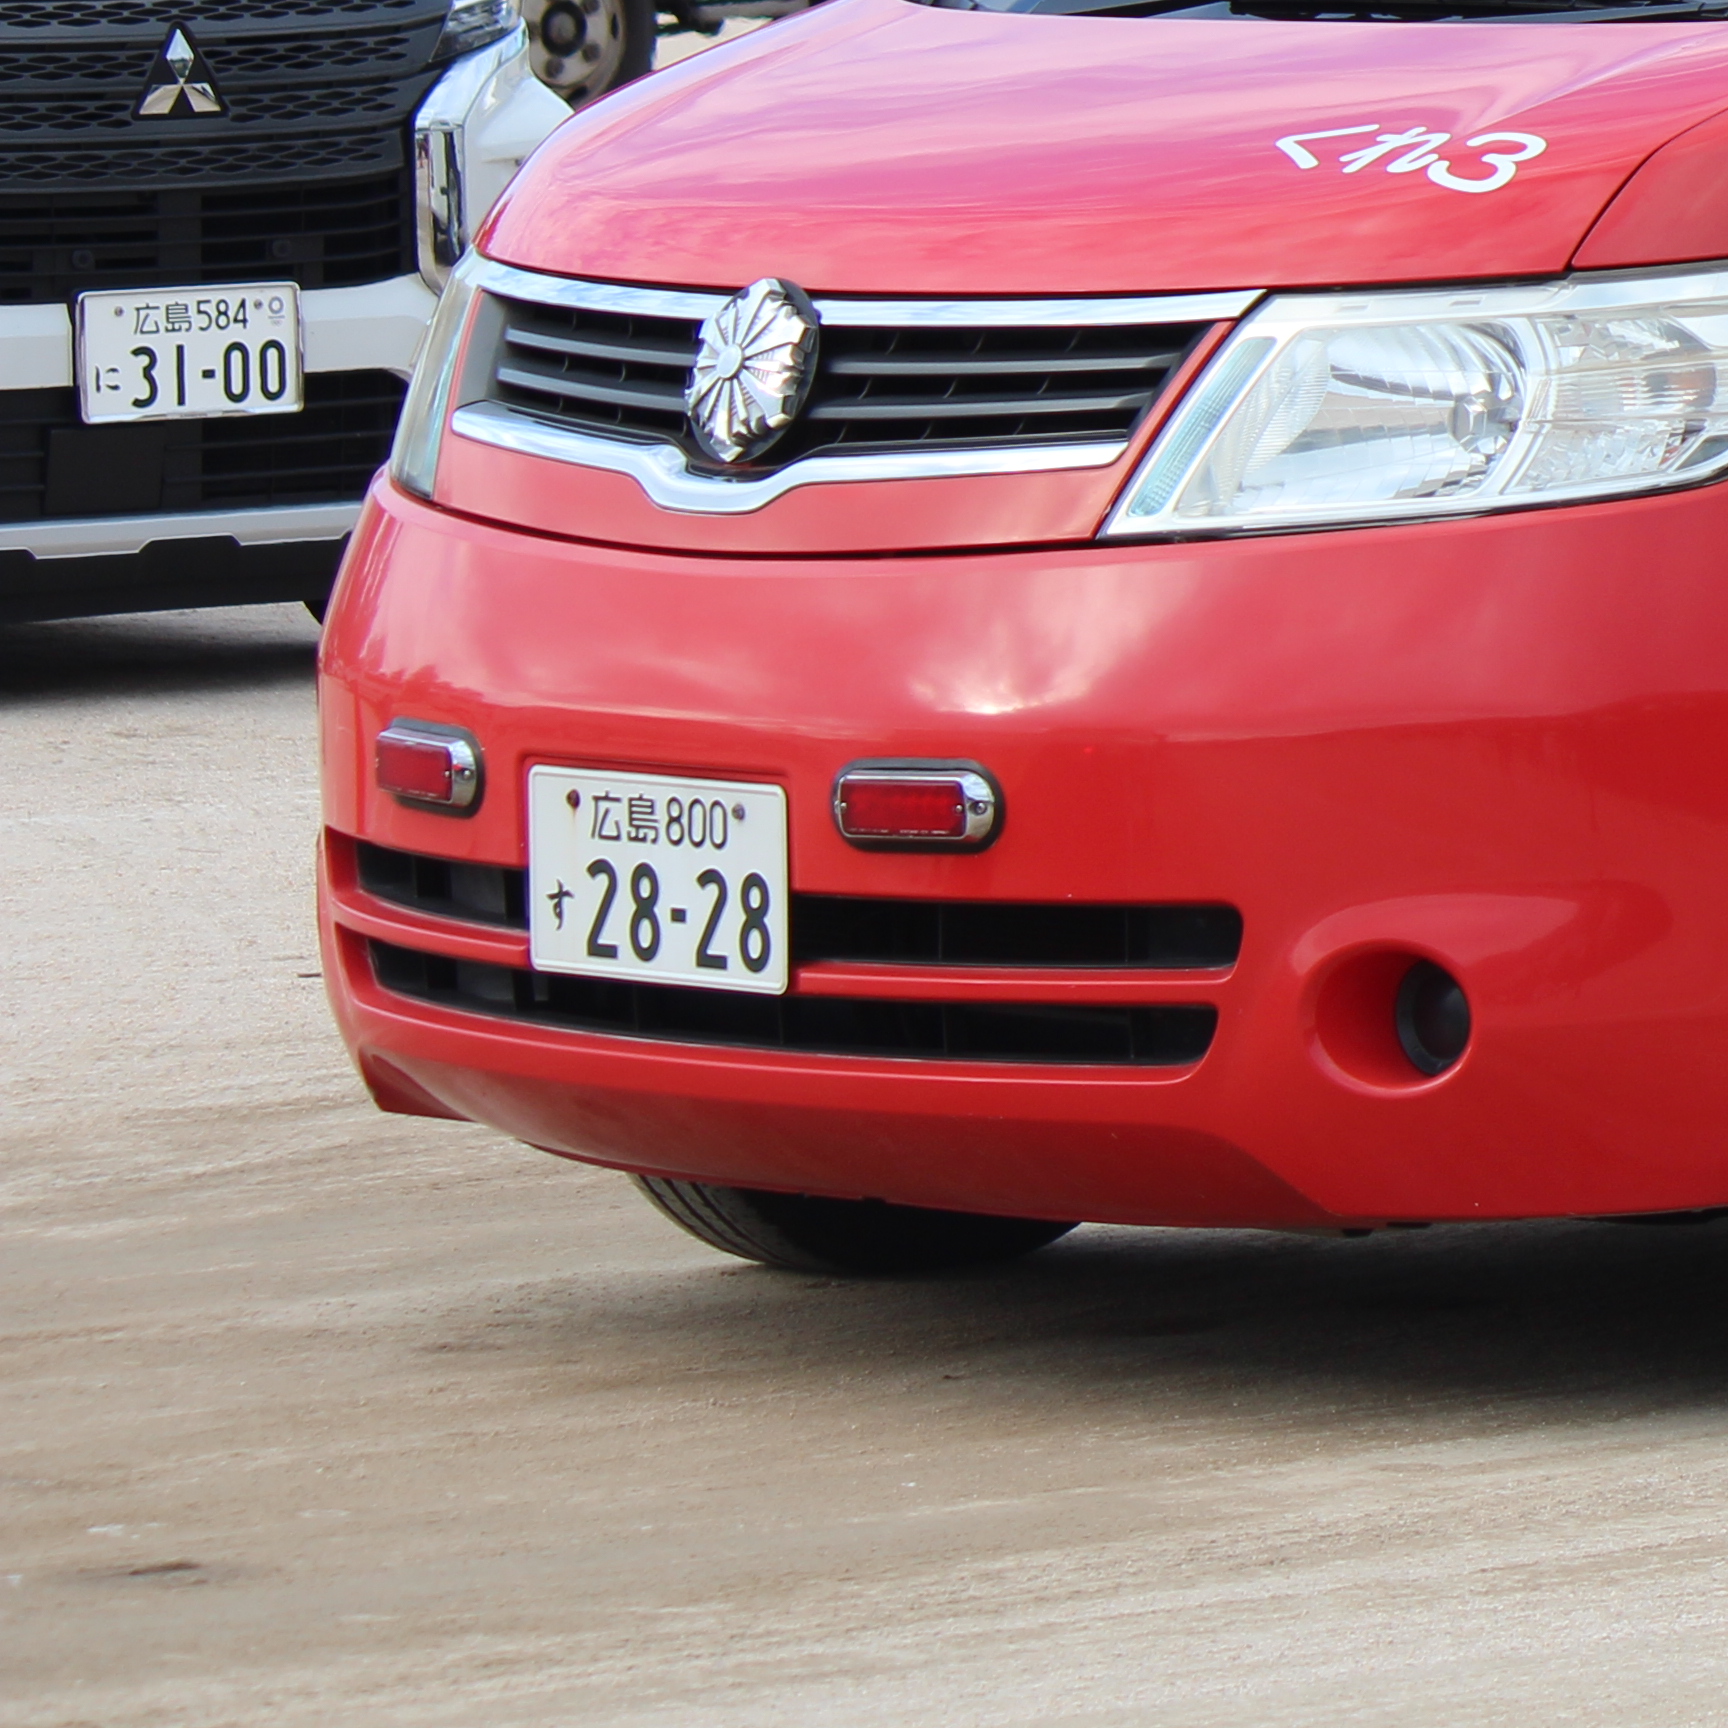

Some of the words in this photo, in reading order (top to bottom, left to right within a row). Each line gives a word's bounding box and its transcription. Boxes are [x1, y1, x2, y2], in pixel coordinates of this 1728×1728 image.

[1274, 123, 1548, 194] くれ3
[133, 297, 249, 335] 広島584
[130, 339, 287, 408] 31-00
[591, 790, 728, 850] 広島800
[546, 878, 575, 932] す
[586, 858, 771, 973] 28-28
